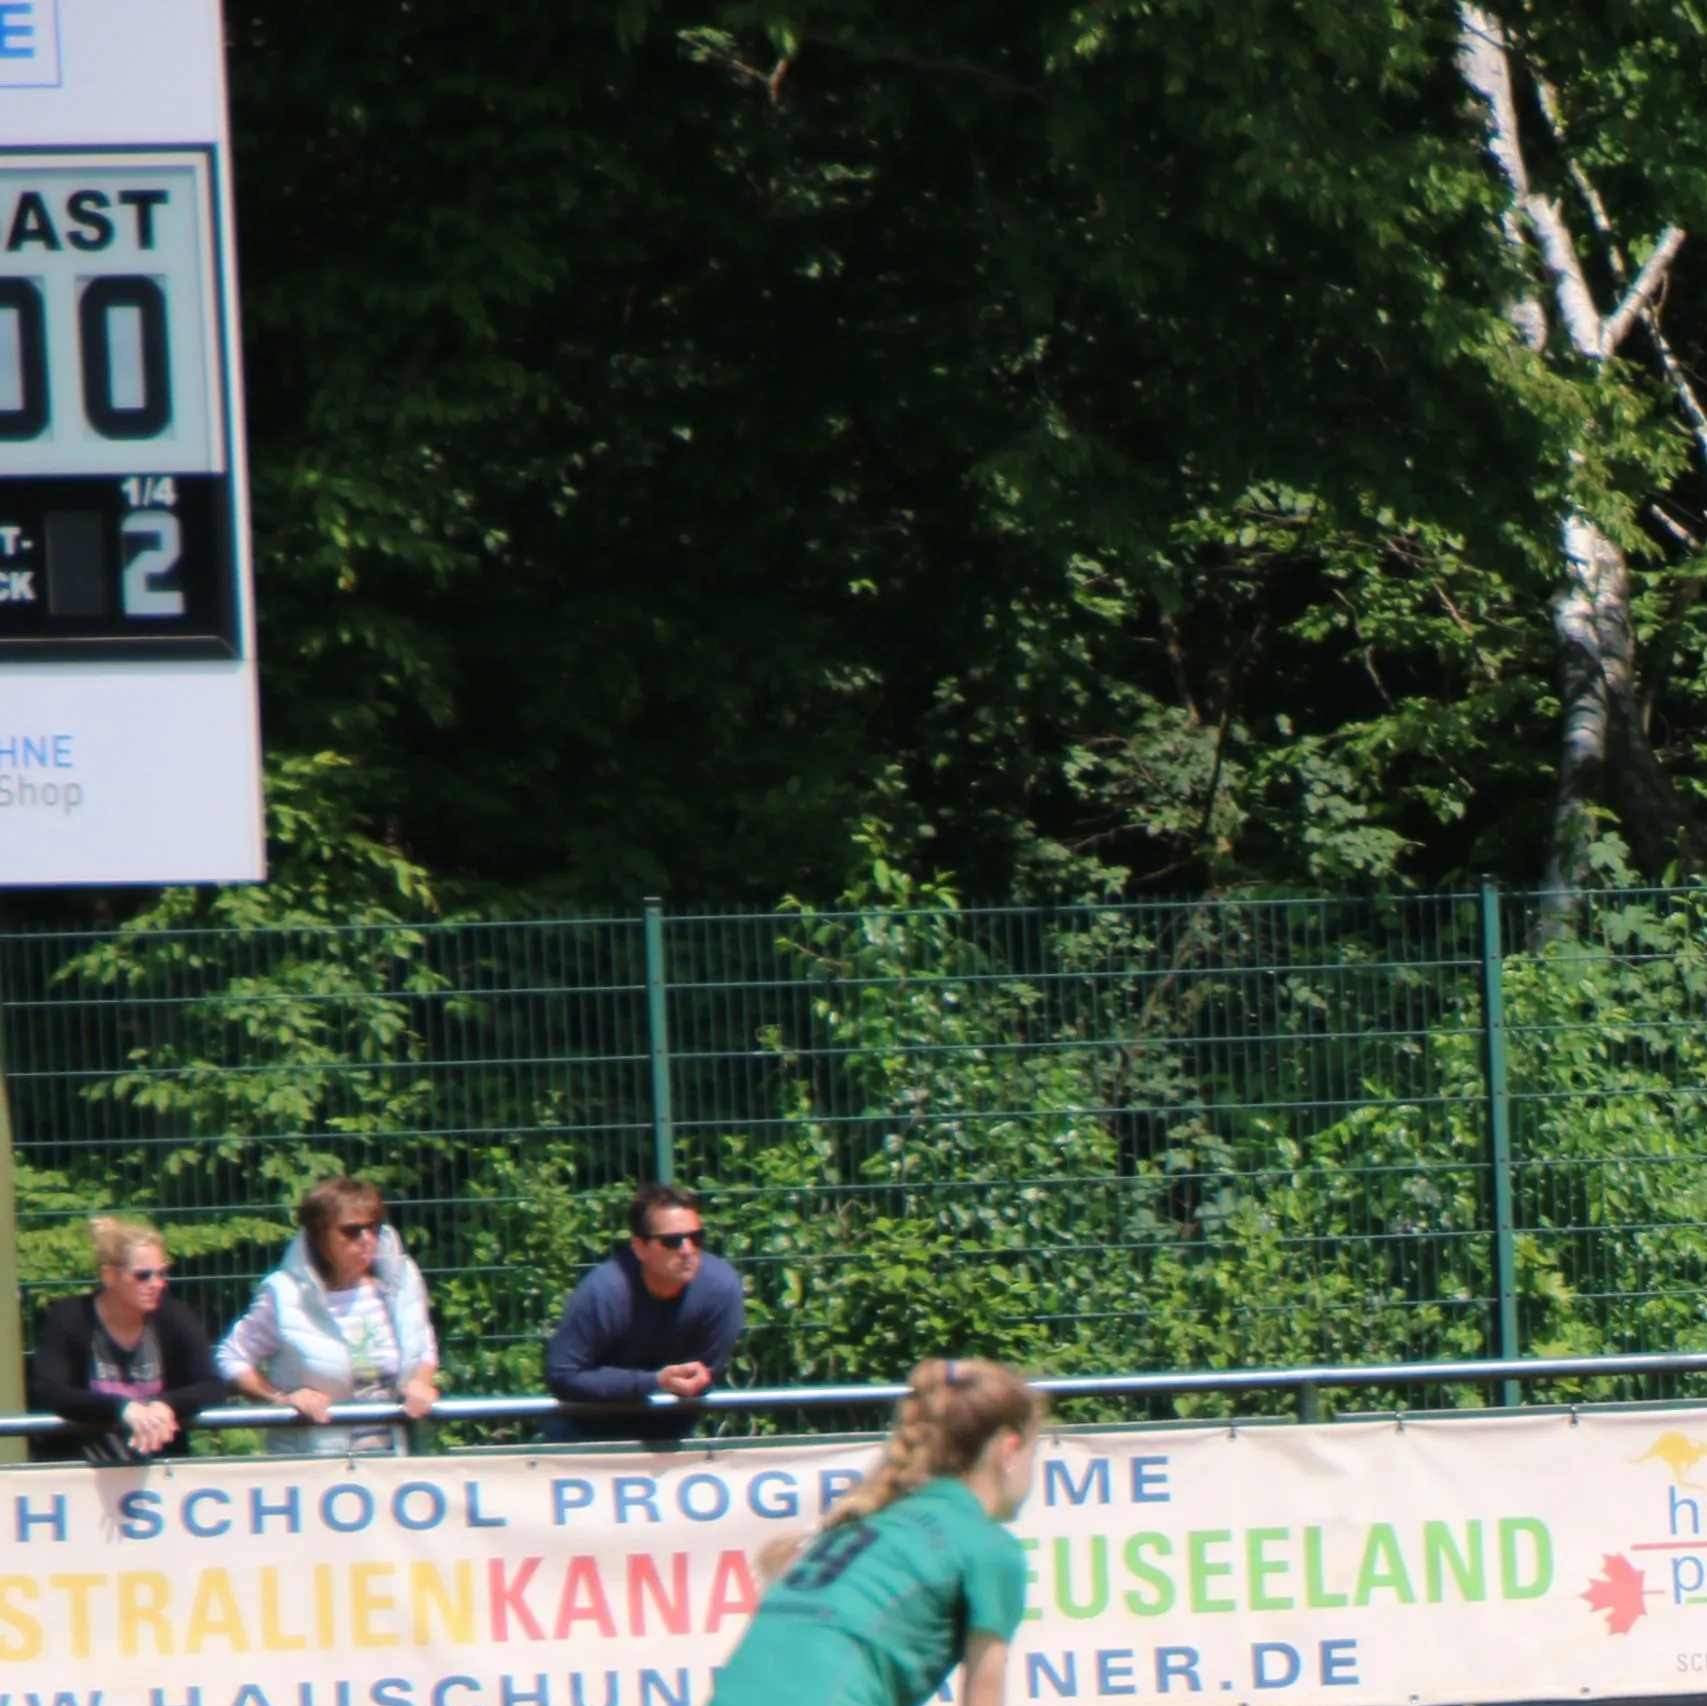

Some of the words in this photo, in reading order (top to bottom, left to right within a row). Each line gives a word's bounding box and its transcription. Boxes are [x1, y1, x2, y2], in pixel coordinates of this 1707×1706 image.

[6, 188, 171, 252] AST
[121, 476, 180, 507] 1/4
[121, 511, 185, 615] 2
[119, 1480, 507, 1541] SCHOOL
